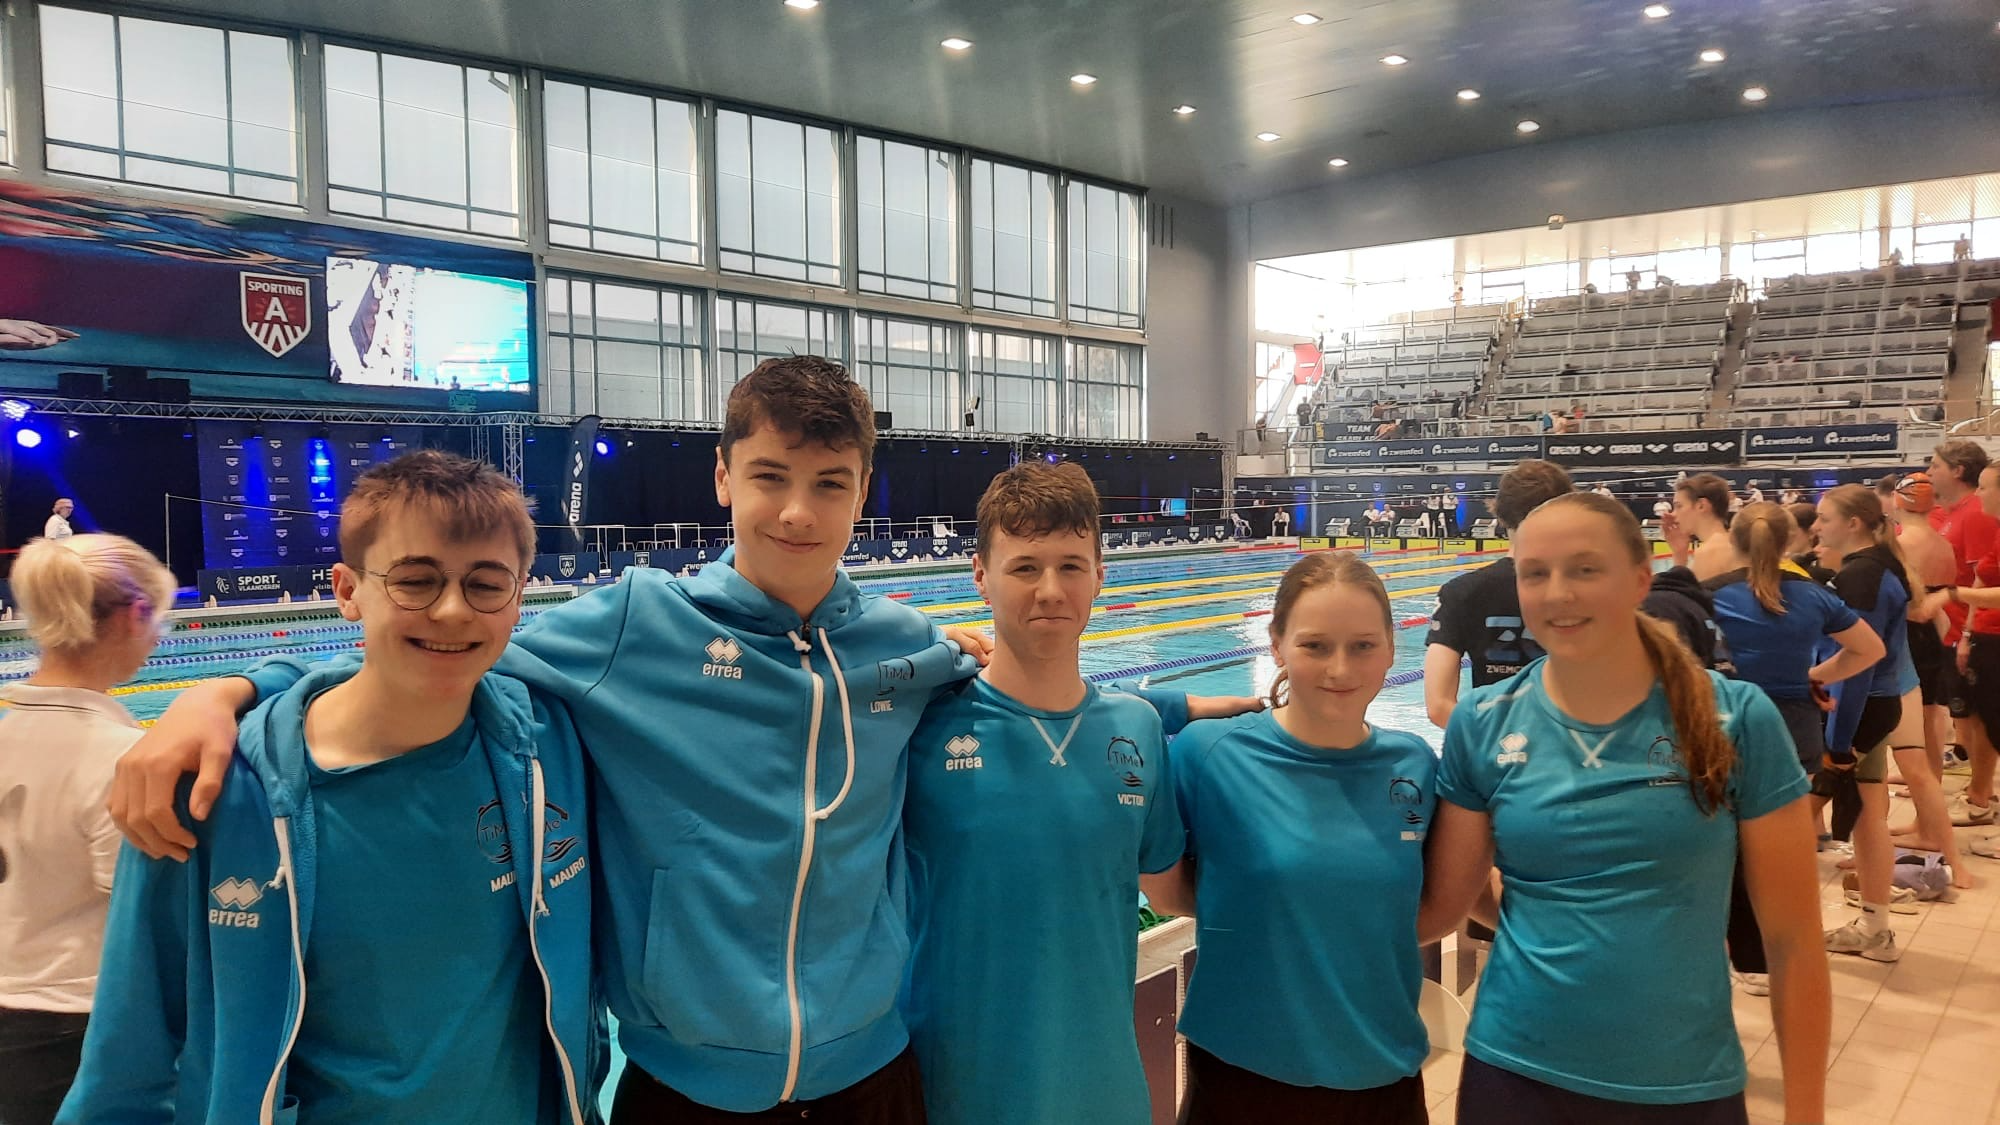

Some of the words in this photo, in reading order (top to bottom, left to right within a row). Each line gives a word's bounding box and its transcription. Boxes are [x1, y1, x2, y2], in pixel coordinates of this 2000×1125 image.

[247, 280, 303, 296] SPORTING
[264, 296, 288, 322] A
[1347, 424, 1371, 433] TEAM
[569, 482, 582, 524] arena
[961, 538, 978, 547] HER
[312, 569, 333, 581] HE
[703, 663, 742, 679] errea
[945, 756, 983, 771] errea
[1117, 793, 1145, 807] VICTOR
[549, 856, 586, 889] MAURO
[490, 871, 516, 893] MAU
[209, 908, 260, 928] errea
